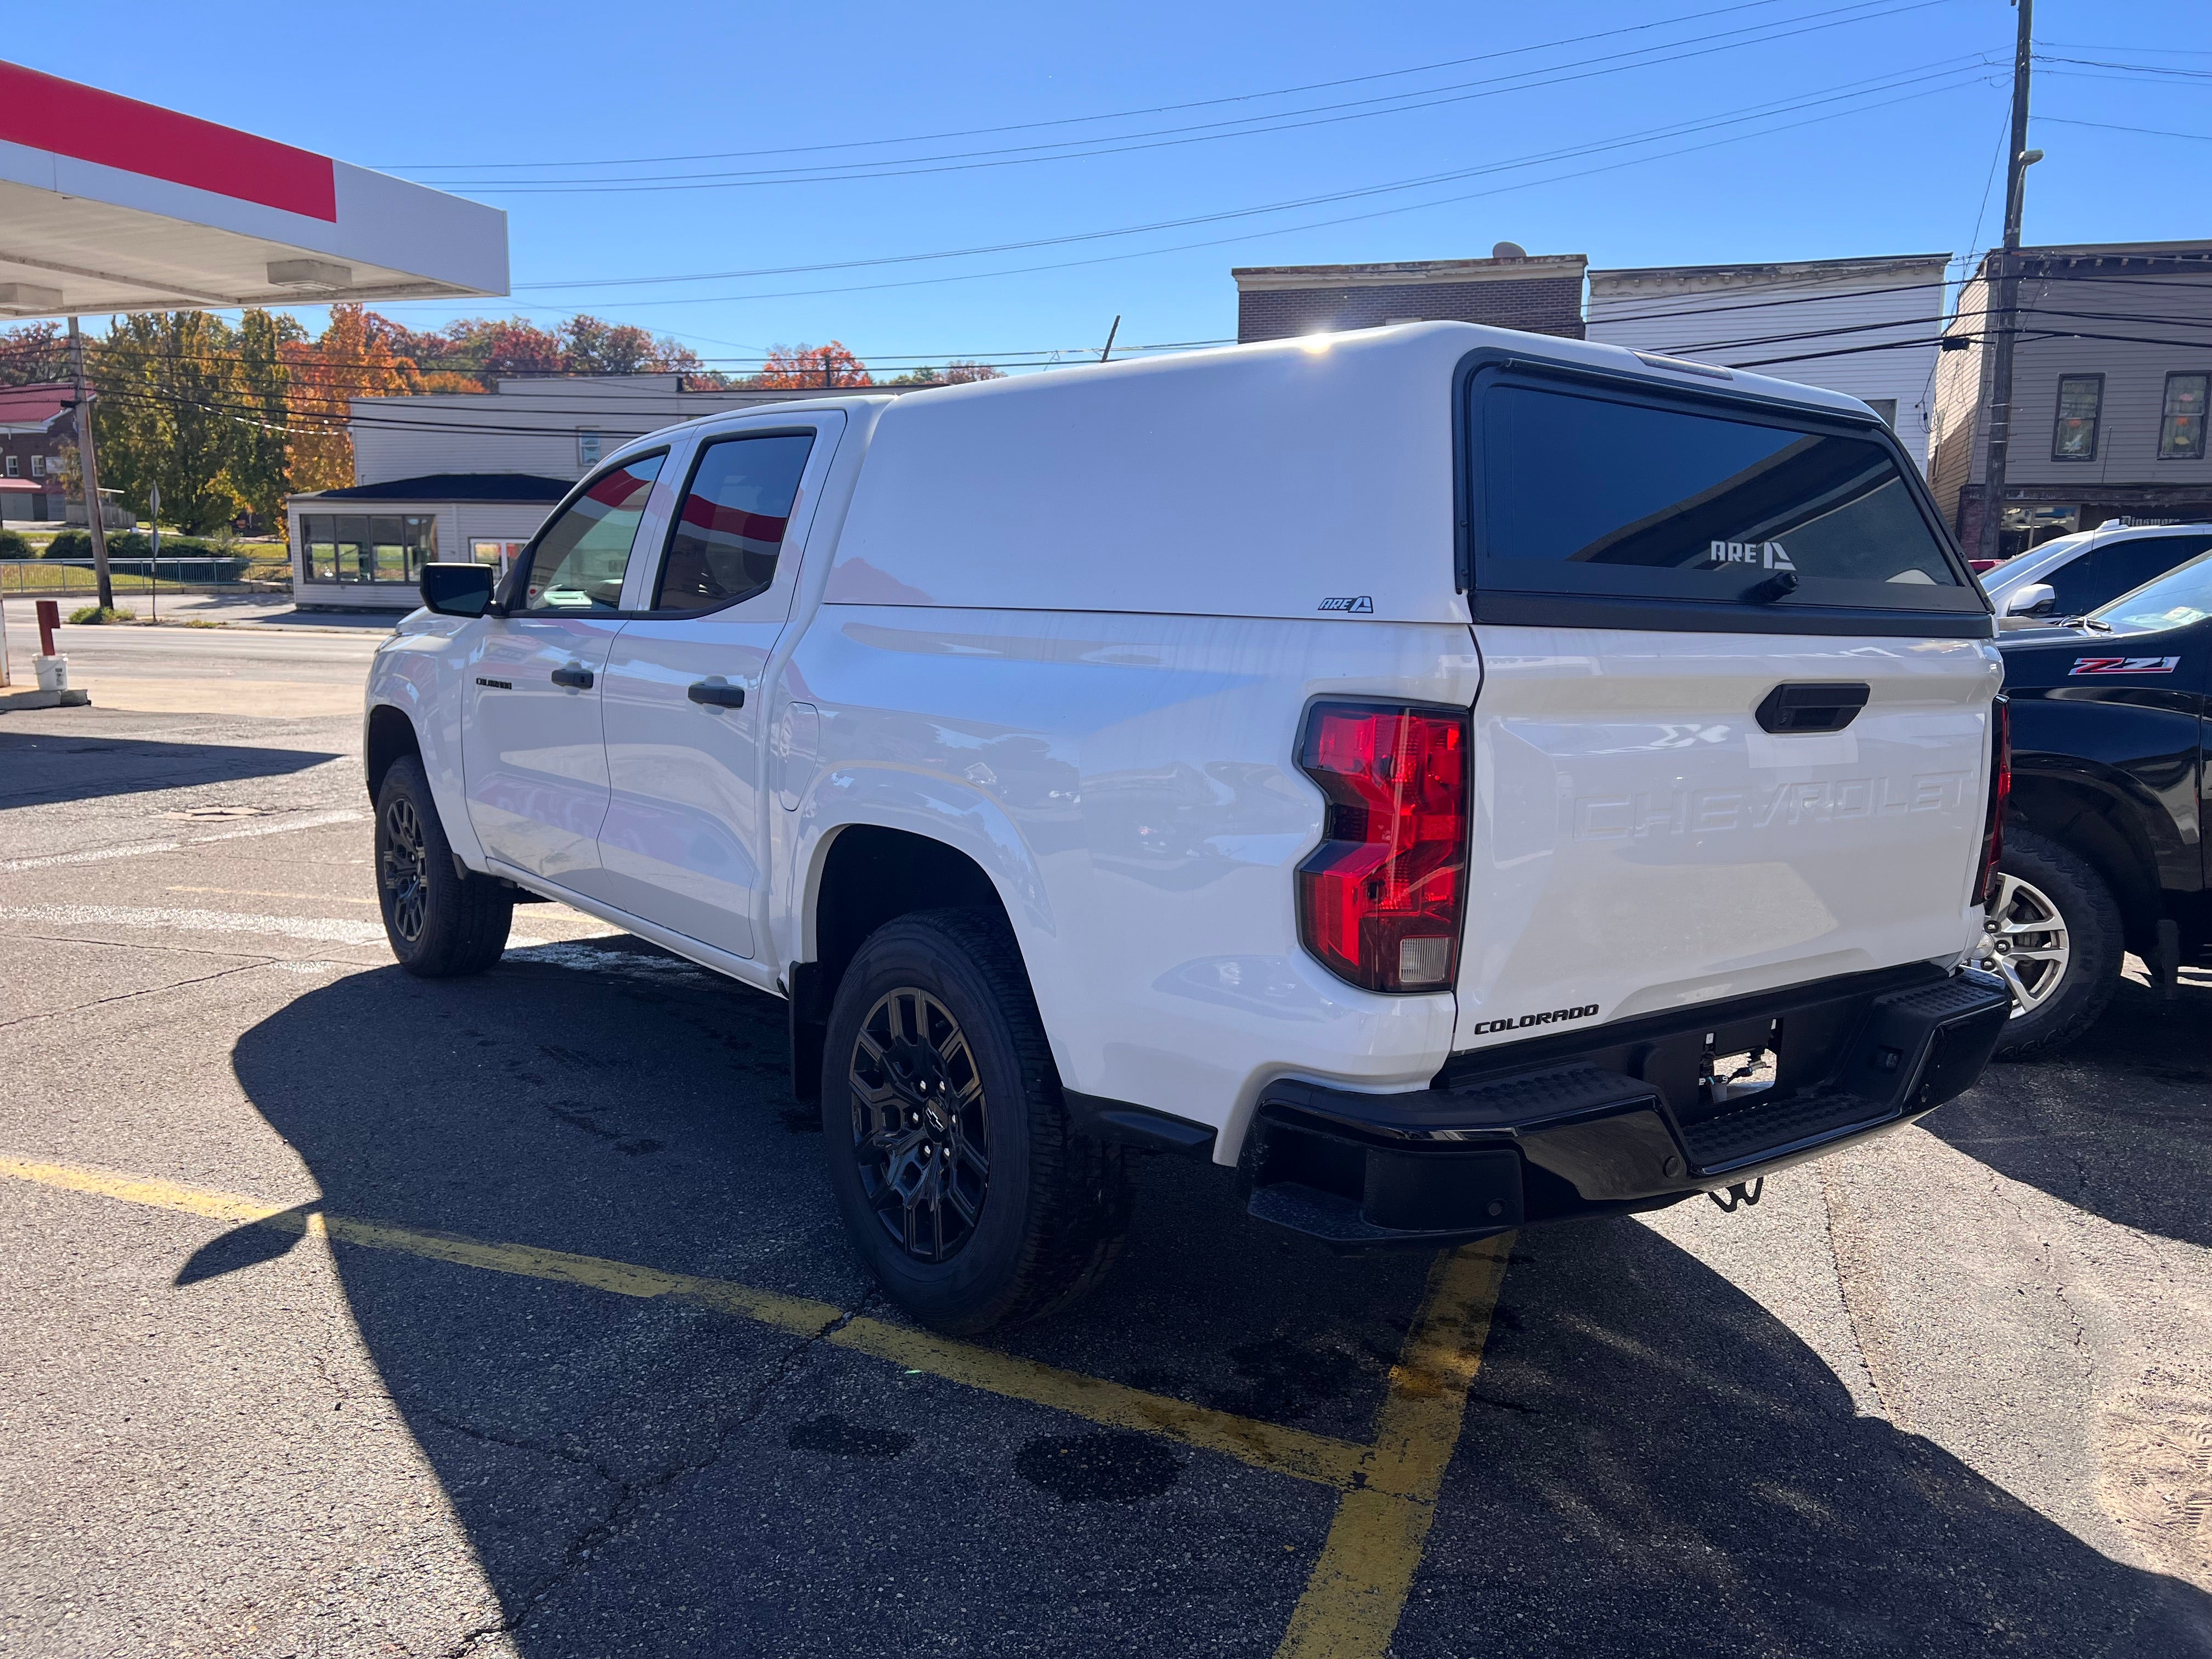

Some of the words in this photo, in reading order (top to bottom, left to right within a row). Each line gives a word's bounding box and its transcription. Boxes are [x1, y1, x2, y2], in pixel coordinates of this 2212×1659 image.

[1711, 541, 1757, 563] ARE
[1318, 599, 1352, 610] ARE
[2068, 656, 2181, 676] Z71
[1572, 769, 1974, 842] CHEVROLET
[1474, 1003, 1599, 1035] COLORADO
